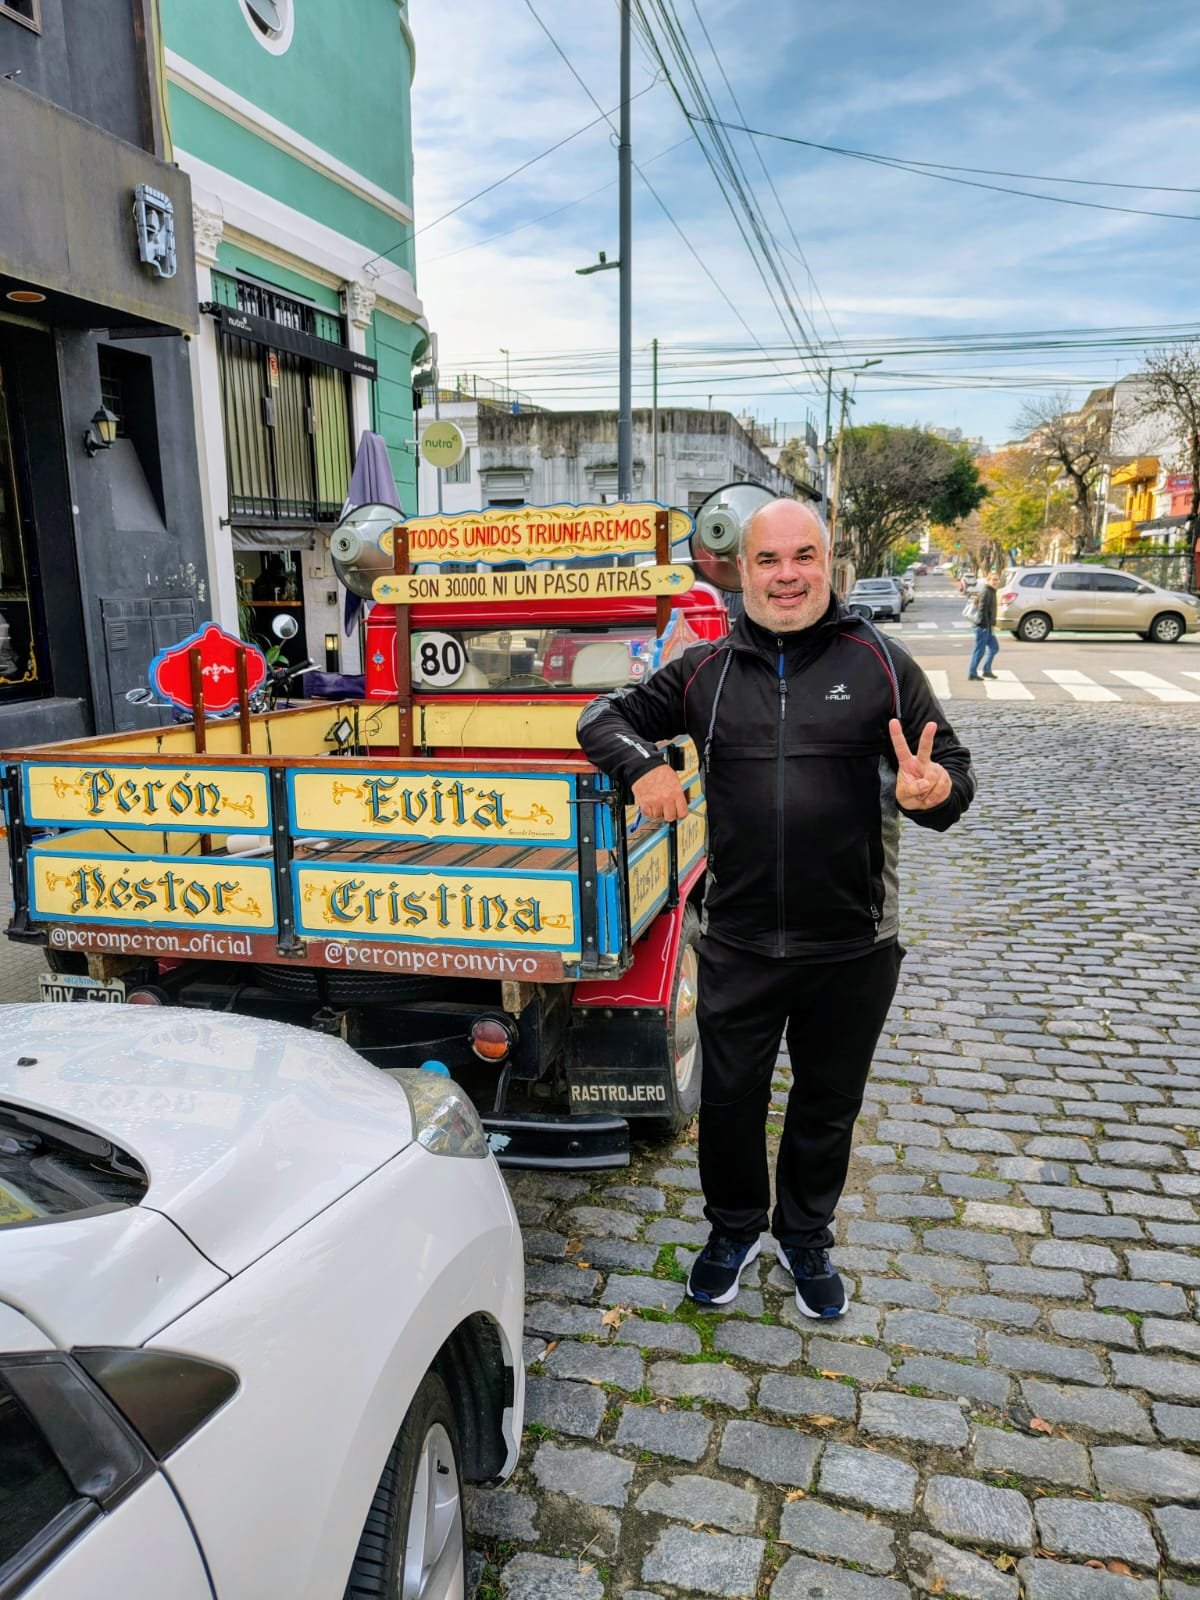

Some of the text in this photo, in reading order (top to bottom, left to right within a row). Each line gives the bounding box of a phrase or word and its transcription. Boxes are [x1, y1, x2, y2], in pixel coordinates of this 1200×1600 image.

[409, 518, 652, 549] TODOS UNIDOS TRIUNFAREMOS
[408, 579, 440, 598] SON
[493, 576, 507, 595] NI
[514, 575, 537, 595] UN
[544, 572, 589, 594] PASO
[596, 568, 652, 592] ATRÁS
[420, 640, 461, 677] 80
[80, 769, 221, 817] Perón
[363, 777, 508, 830] Evita
[71, 866, 240, 918] Néstor
[328, 878, 544, 935] Cristina
[50, 927, 253, 956] @peronperon_oficial
[324, 942, 538, 973] @peronperonvivo
[571, 1085, 666, 1101] RASTROJERO
